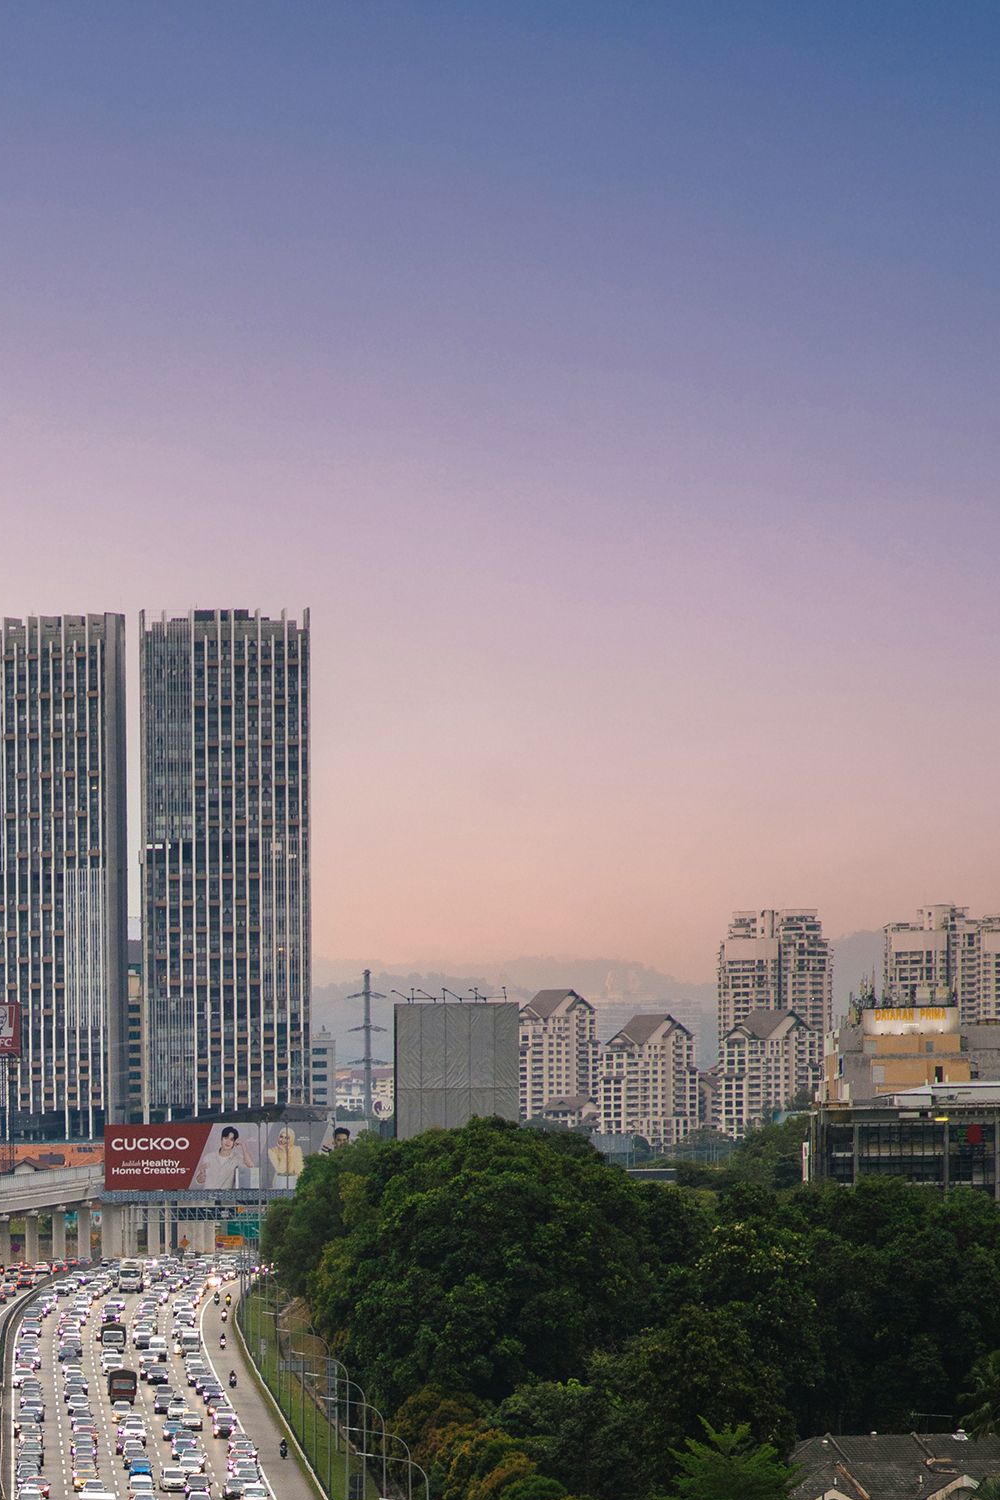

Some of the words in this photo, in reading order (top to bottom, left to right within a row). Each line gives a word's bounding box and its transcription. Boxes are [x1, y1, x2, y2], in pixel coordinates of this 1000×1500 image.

[875, 1008, 914, 1021] DATARAN
[920, 1008, 946, 1020] PRIMA
[111, 1137, 190, 1151] CUCKOO
[141, 1159, 180, 1168] Healthy
[111, 1167, 141, 1175] Home
